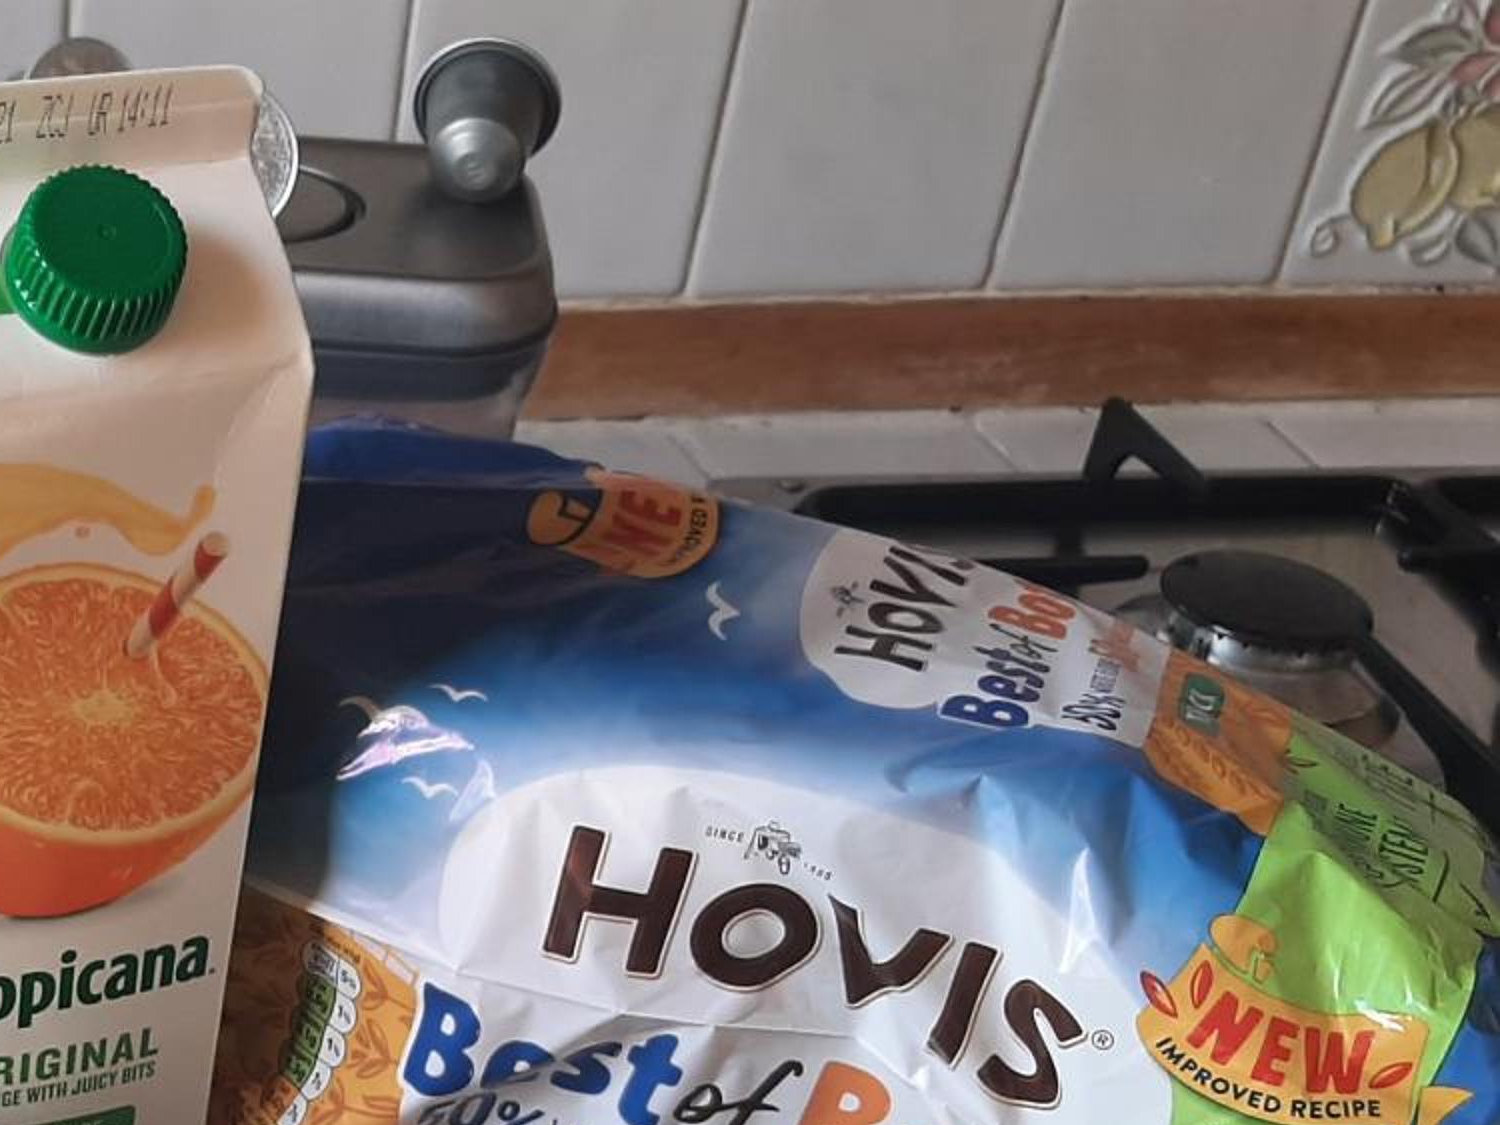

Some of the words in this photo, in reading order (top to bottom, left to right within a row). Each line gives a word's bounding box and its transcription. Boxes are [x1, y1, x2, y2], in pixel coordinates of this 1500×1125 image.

[988, 580, 1077, 641] Bo
[941, 645, 1050, 728] Best
[705, 826, 745, 843] SINCE
[542, 825, 1088, 1108] HOVIS
[26, 1081, 68, 1105] WITH
[70, 1072, 119, 1098] JUICY
[122, 1062, 157, 1086] BITS
[1155, 1036, 1282, 1114] IMPROVED
[1289, 1098, 1383, 1119] RECIPE
[1185, 989, 1376, 1096] NEW
